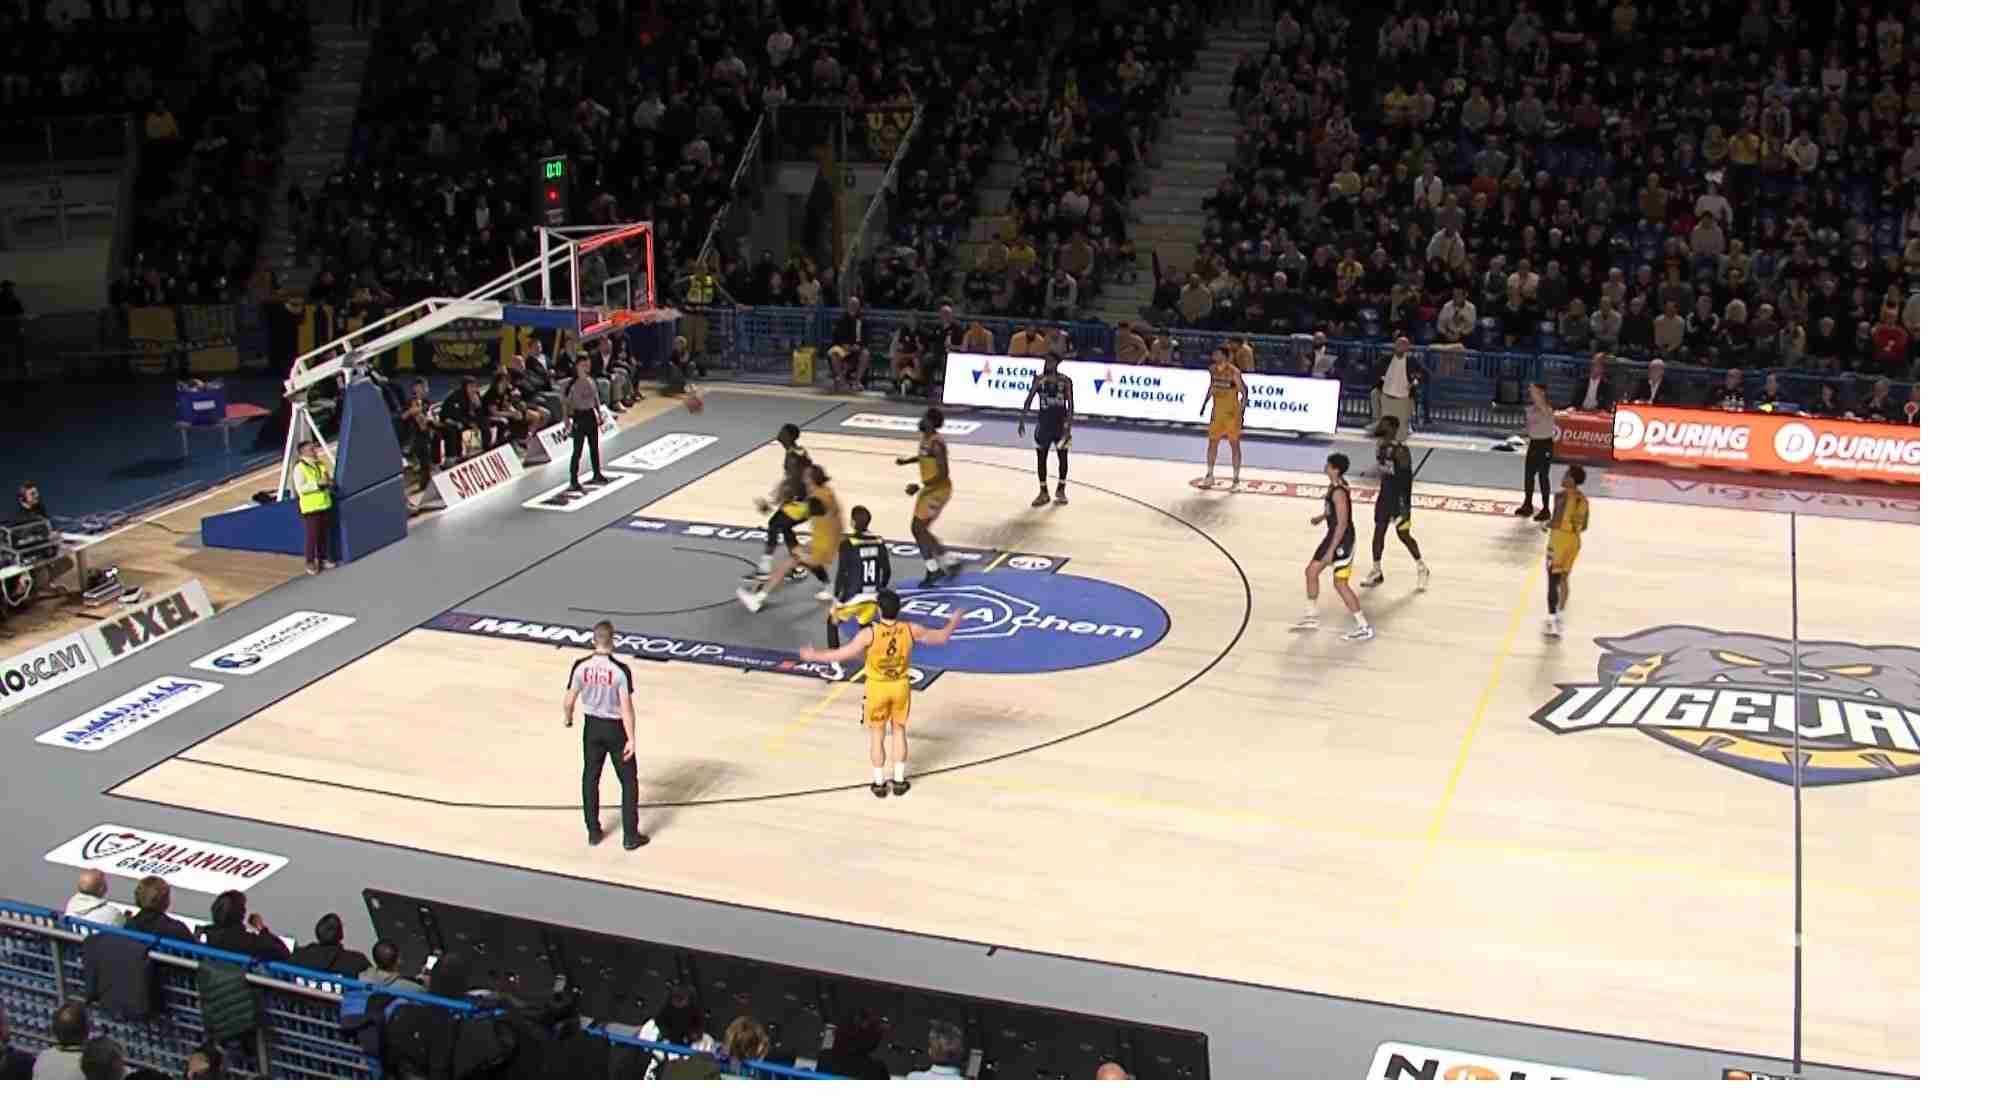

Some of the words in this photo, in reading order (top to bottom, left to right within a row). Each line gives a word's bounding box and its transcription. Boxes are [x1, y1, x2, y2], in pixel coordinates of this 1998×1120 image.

[996, 366, 1037, 377] ASCON
[1119, 375, 1161, 387] ASCON
[987, 379, 1032, 392] TECNOL
[1109, 387, 1186, 403] TECNOLOGIC
[1251, 385, 1285, 397] SCON
[1246, 399, 1309, 413] CNOLOGIC
[1644, 420, 1751, 450] DURING
[1813, 432, 1921, 465] DURING
[449, 451, 512, 500] SATOLLINI
[862, 559, 876, 583] 14
[1544, 684, 1921, 752] VIGEVA
[139, 841, 270, 878] VALANDRO
